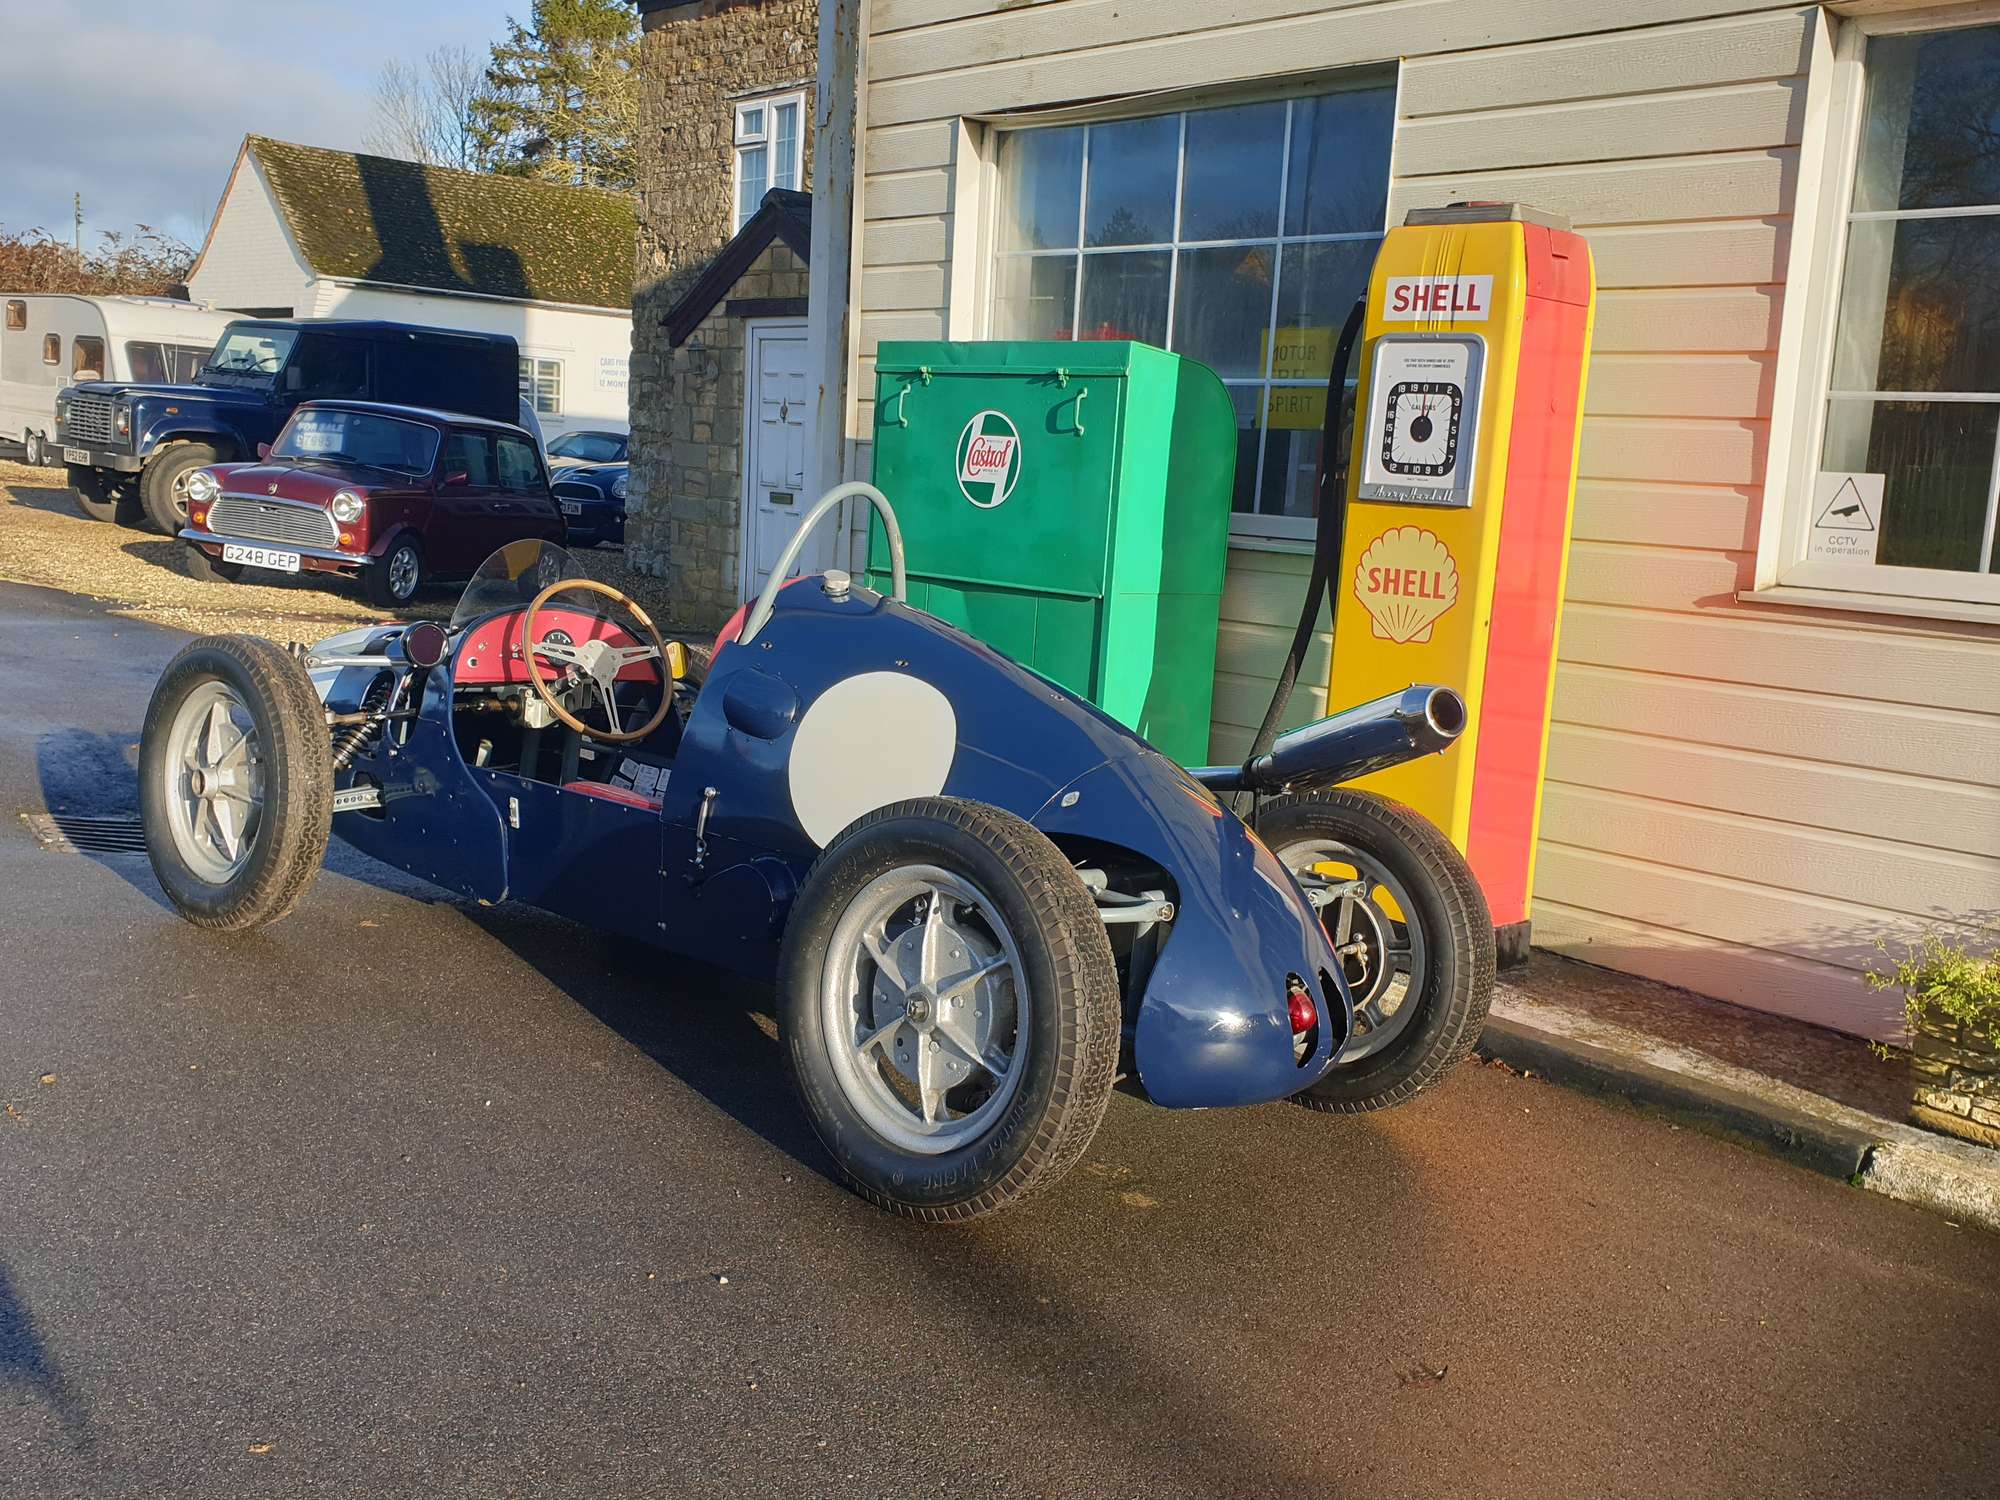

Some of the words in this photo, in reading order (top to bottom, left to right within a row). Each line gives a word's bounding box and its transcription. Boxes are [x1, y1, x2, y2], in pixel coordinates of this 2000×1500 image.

[1392, 284, 1481, 312] SHELL
[1398, 384, 1406, 393] 18
[1410, 383, 1418, 392] 19
[1446, 386, 1453, 394] 2
[1388, 396, 1397, 404] 17
[1454, 398, 1460, 407] 3
[1387, 411, 1395, 419] 16
[1452, 413, 1458, 421] 4
[1385, 423, 1393, 432] 15
[1450, 426, 1457, 434] 5
[1384, 436, 1392, 445] 14
[1449, 440, 1455, 448] 6
[967, 437, 1012, 476] Castrol
[1382, 451, 1390, 460] 13
[1448, 455, 1454, 463] 7
[1389, 463, 1398, 472] 12
[1404, 465, 1409, 473] 11
[1413, 465, 1420, 474] 10
[1425, 466, 1431, 475] 9
[1437, 466, 1444, 474] 8
[1828, 535, 1858, 546] CCTV
[1814, 545, 1823, 553] in
[1825, 546, 1870, 556] operation
[225, 546, 264, 565] G248
[267, 552, 298, 568] GEP
[1367, 567, 1446, 600] SHELL
